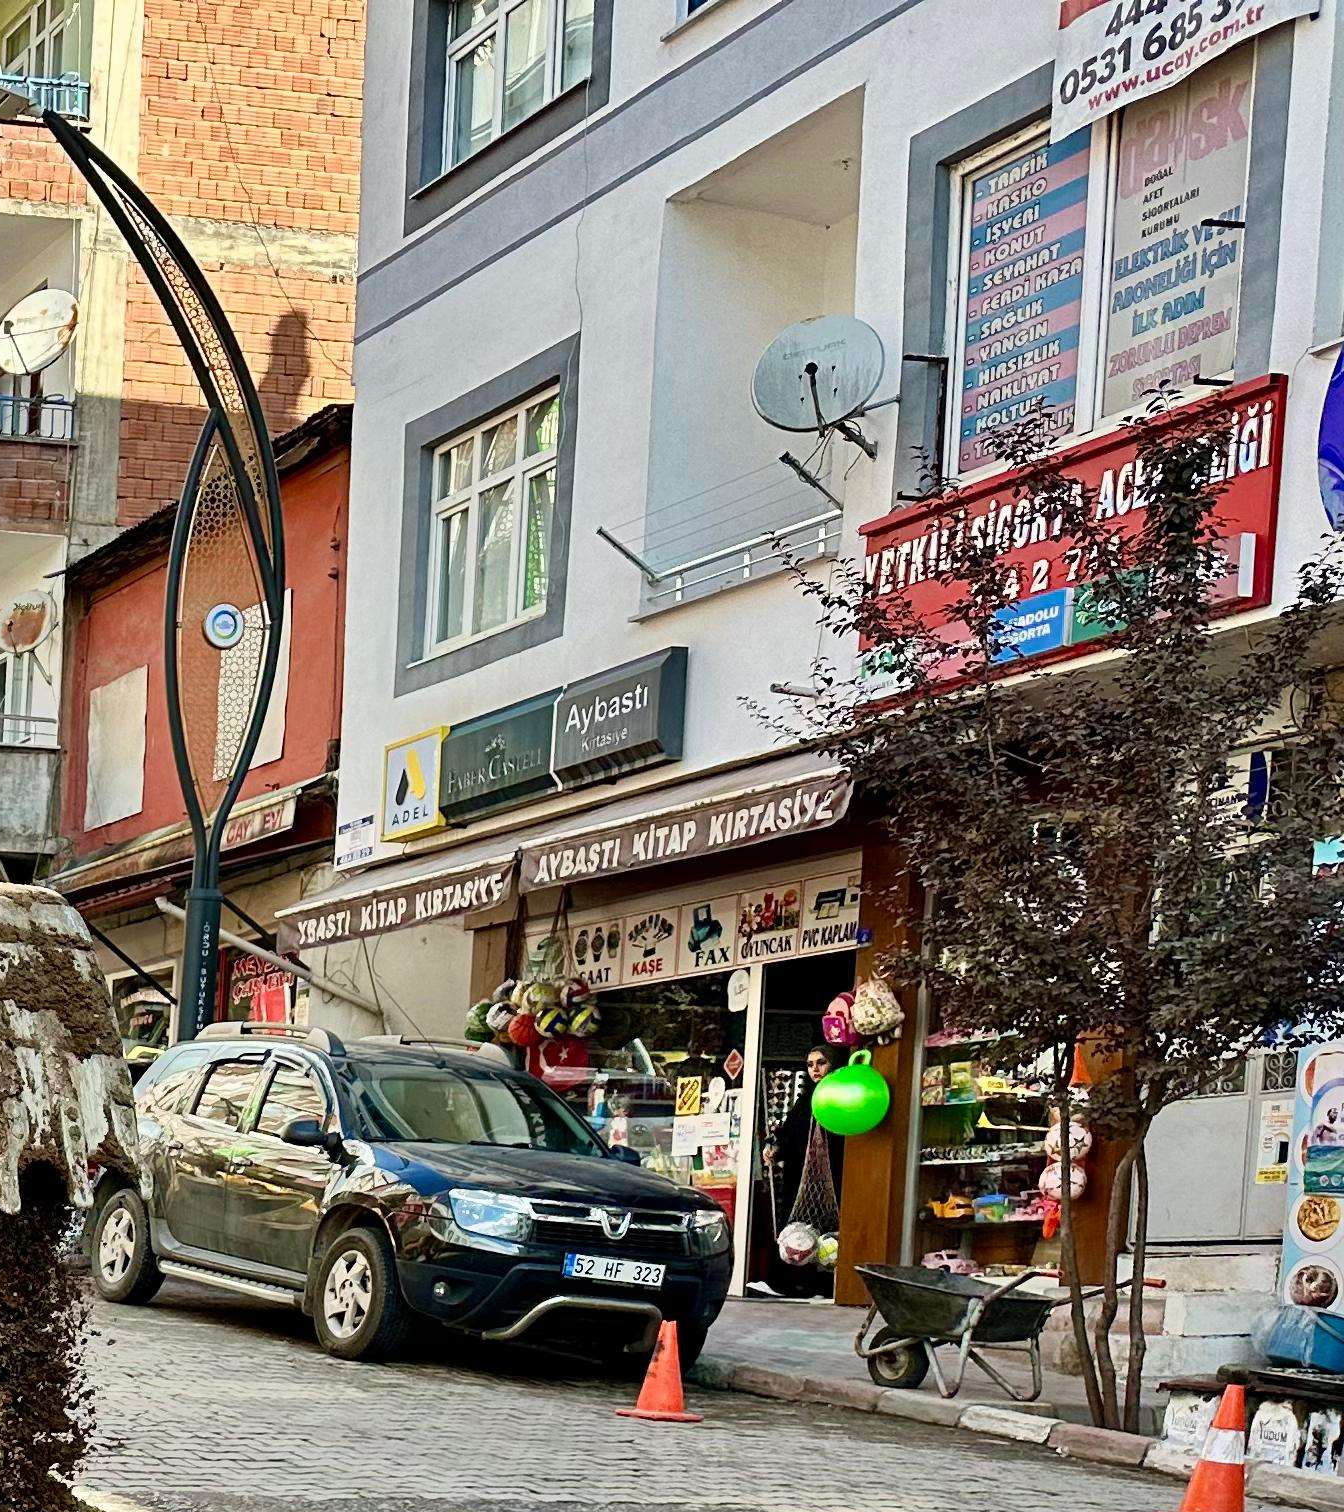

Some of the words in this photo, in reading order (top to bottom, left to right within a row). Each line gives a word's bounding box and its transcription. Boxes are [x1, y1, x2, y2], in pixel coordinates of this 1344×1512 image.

[1059, 36, 1133, 105] 0531
[1142, 5, 1203, 61] 685
[988, 152, 1049, 195] TRAFİK
[985, 199, 1041, 245] İŞYERİ
[986, 177, 1048, 220] KASKO
[982, 243, 1062, 292] SEYAHAT
[984, 224, 1047, 268] KONUT
[1114, 228, 1190, 282] ELEKTRİK
[981, 275, 1031, 316] FERDİ
[1035, 256, 1084, 292] KAZA
[1112, 252, 1198, 315] ABONELİĞİ
[1201, 240, 1238, 279] İÇİN
[980, 297, 1044, 341] SAĞLIK
[1132, 305, 1159, 338] İLK
[1161, 286, 1206, 325] ADIM
[978, 338, 1062, 387] HIRSIZLIK
[979, 319, 1050, 363] YANGIN
[976, 362, 1062, 412] NAKLİYAT
[564, 683, 650, 736] Aybastı
[580, 726, 630, 753] Kırtasiye
[391, 803, 430, 827] ADEL
[533, 838, 621, 884] AYBASTI
[629, 820, 697, 868] KİTAP
[707, 786, 836, 846] KIRTASİYE
[359, 895, 408, 933] KİTAP
[413, 872, 506, 920] KIRTASİYE
[631, 956, 664, 977] KAŞE
[694, 946, 732, 968] FAX
[740, 933, 794, 960] OYUNCAK
[800, 926, 821, 950] PVC
[574, 1257, 596, 1276] 52
[603, 1261, 625, 1279] HF
[632, 1265, 662, 1284] 323
